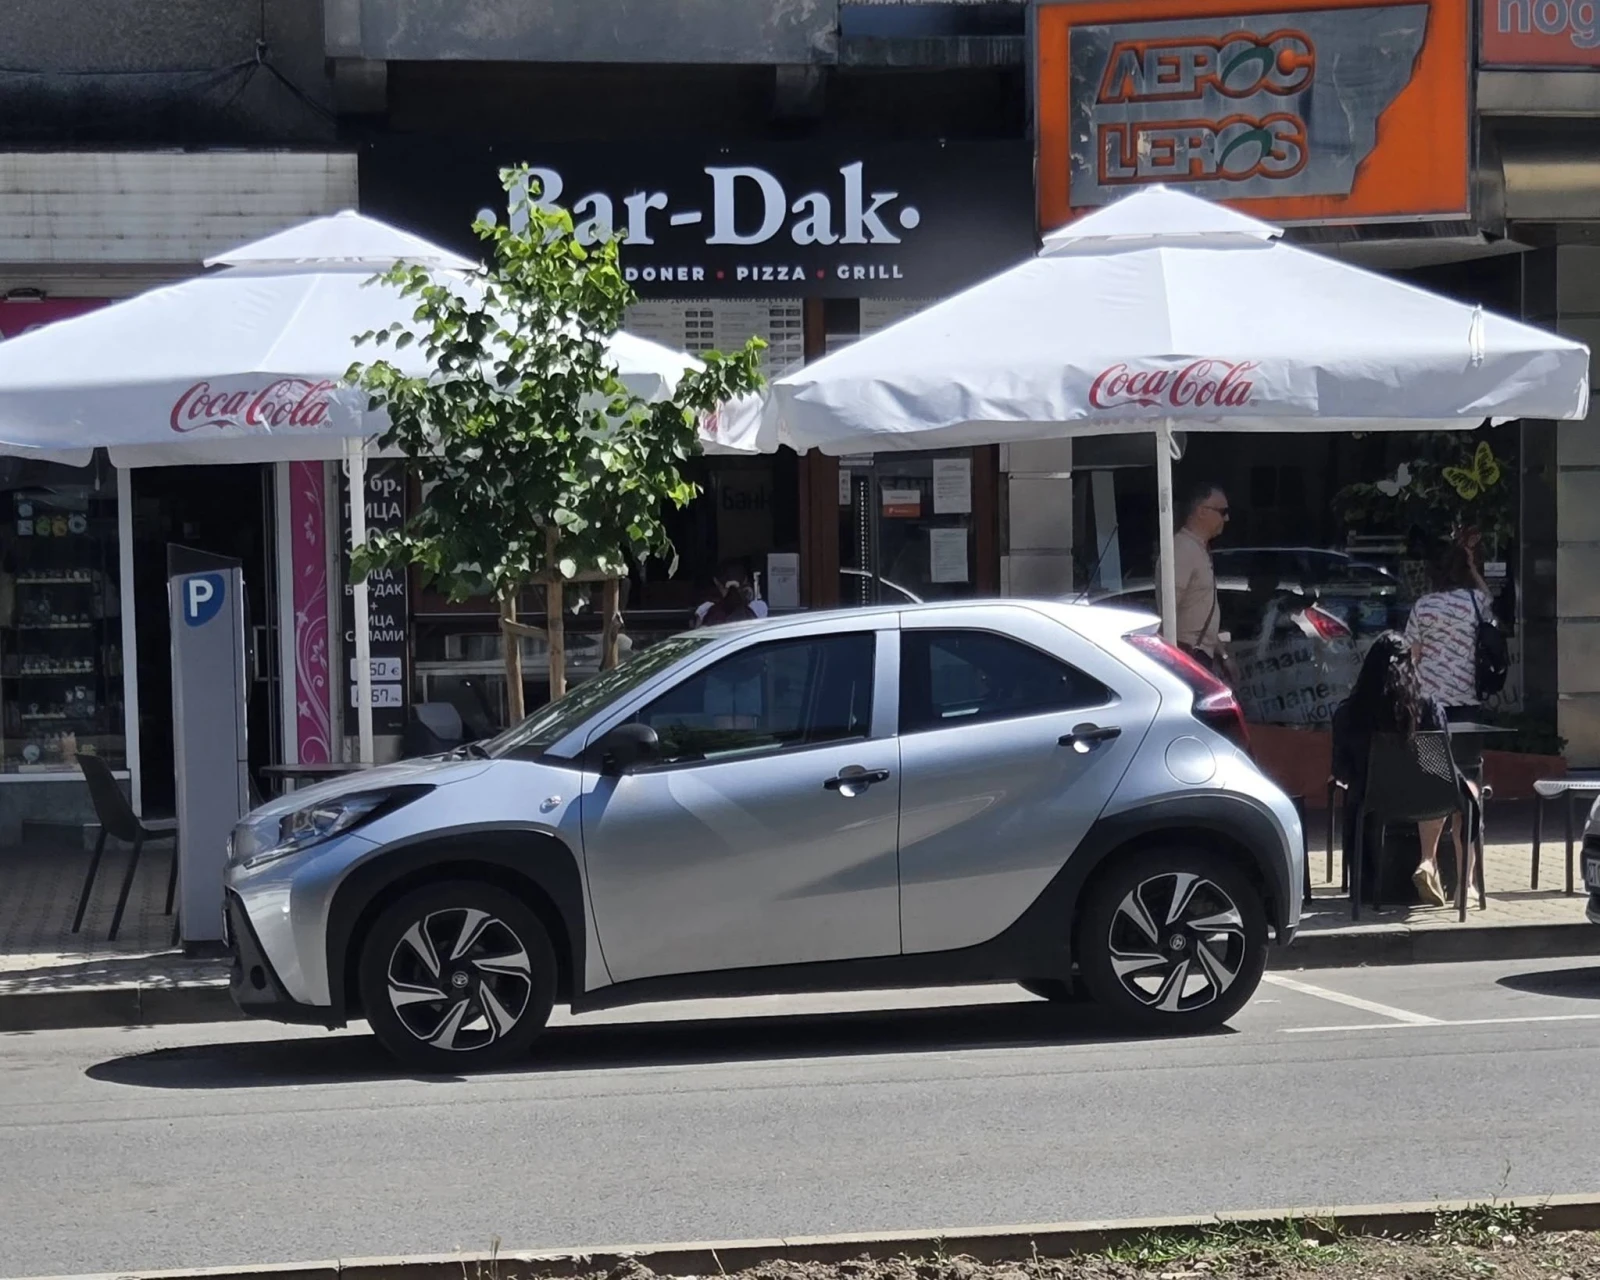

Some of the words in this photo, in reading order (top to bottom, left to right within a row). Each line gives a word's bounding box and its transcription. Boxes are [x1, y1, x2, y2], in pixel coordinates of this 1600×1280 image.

[1098, 113, 1309, 185] LEROS
[625, 267, 705, 281] DONER
[737, 266, 806, 281] PIZZA
[837, 265, 903, 280] GRILL
[189, 580, 214, 617] P
[345, 584, 404, 598] Б-ДАК
[368, 614, 395, 628] ИЦА
